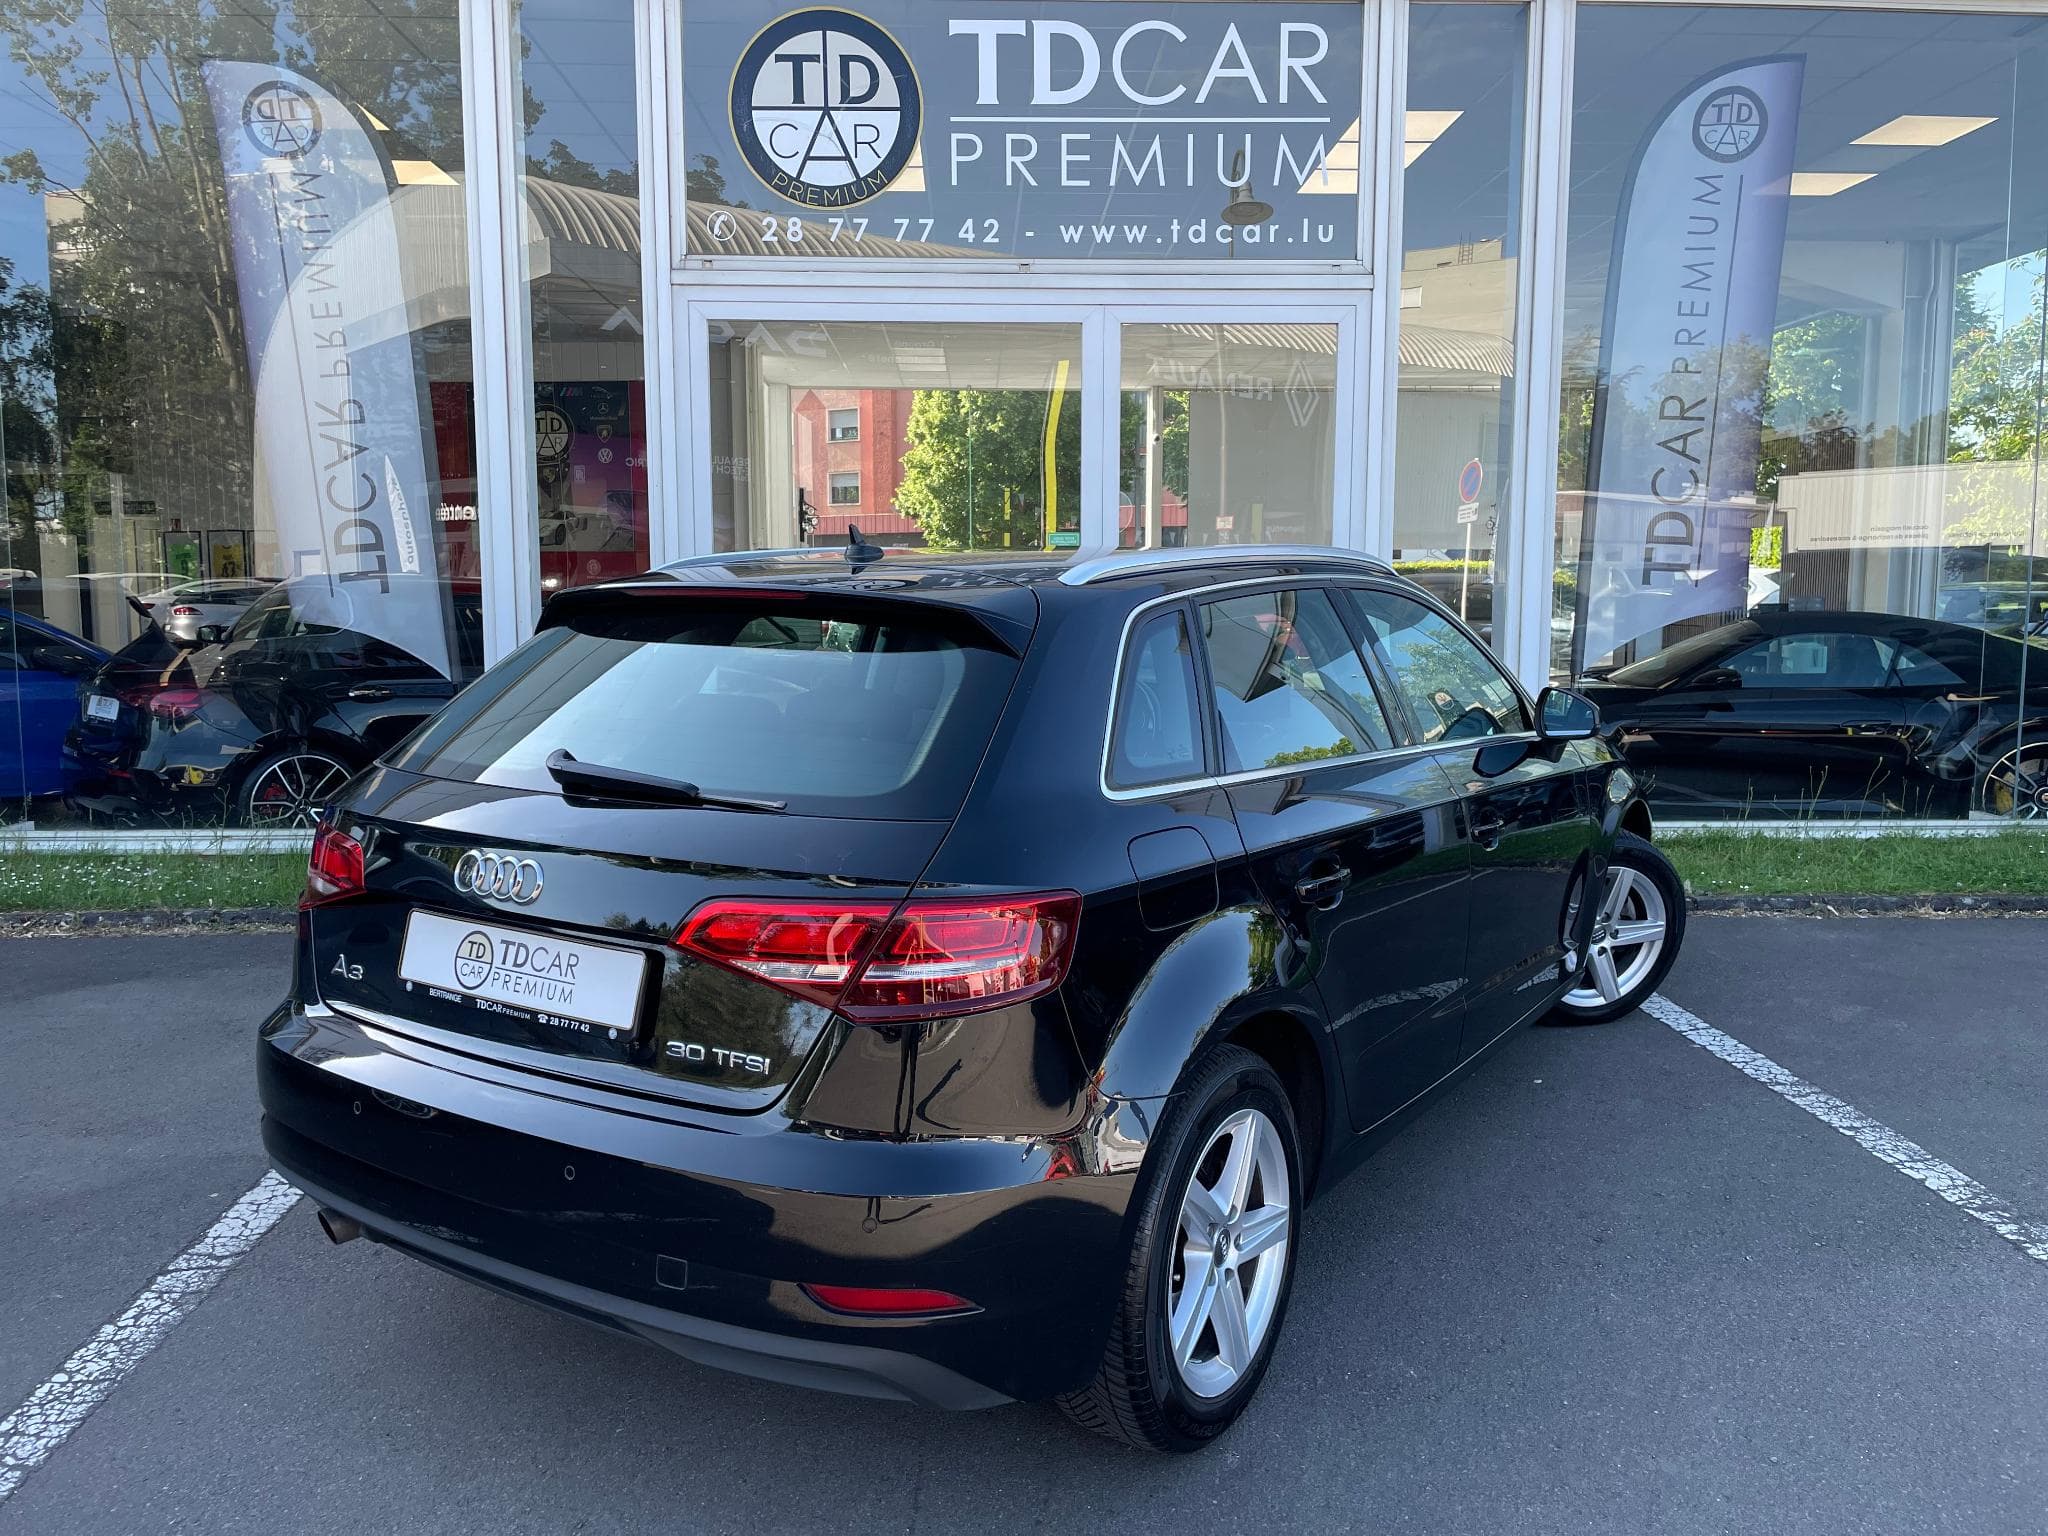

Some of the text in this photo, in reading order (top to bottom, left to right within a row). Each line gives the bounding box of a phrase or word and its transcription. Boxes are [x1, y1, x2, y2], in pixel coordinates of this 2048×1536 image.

[949, 20, 1329, 105] TDCAR
[950, 132, 1329, 187] PREMIUM
[771, 169, 888, 207] PREMIUM
[761, 217, 803, 242] 28
[828, 218, 869, 242] 77
[894, 218, 934, 242] 77
[958, 218, 1000, 243] 42
[1059, 218, 1334, 243] www.tdcar.lu
[1642, 174, 1724, 587] TDCAR PREMIUM
[331, 954, 363, 980] A3
[467, 940, 486, 959] TD
[500, 939, 579, 979] TDCAR
[460, 962, 484, 979] CAR
[491, 971, 574, 1005] PREMIUM
[429, 987, 590, 1033] BERTRANGE TDCAR PREMIUM 28 77 77 42
[666, 1041, 771, 1075] 30 TFSI
